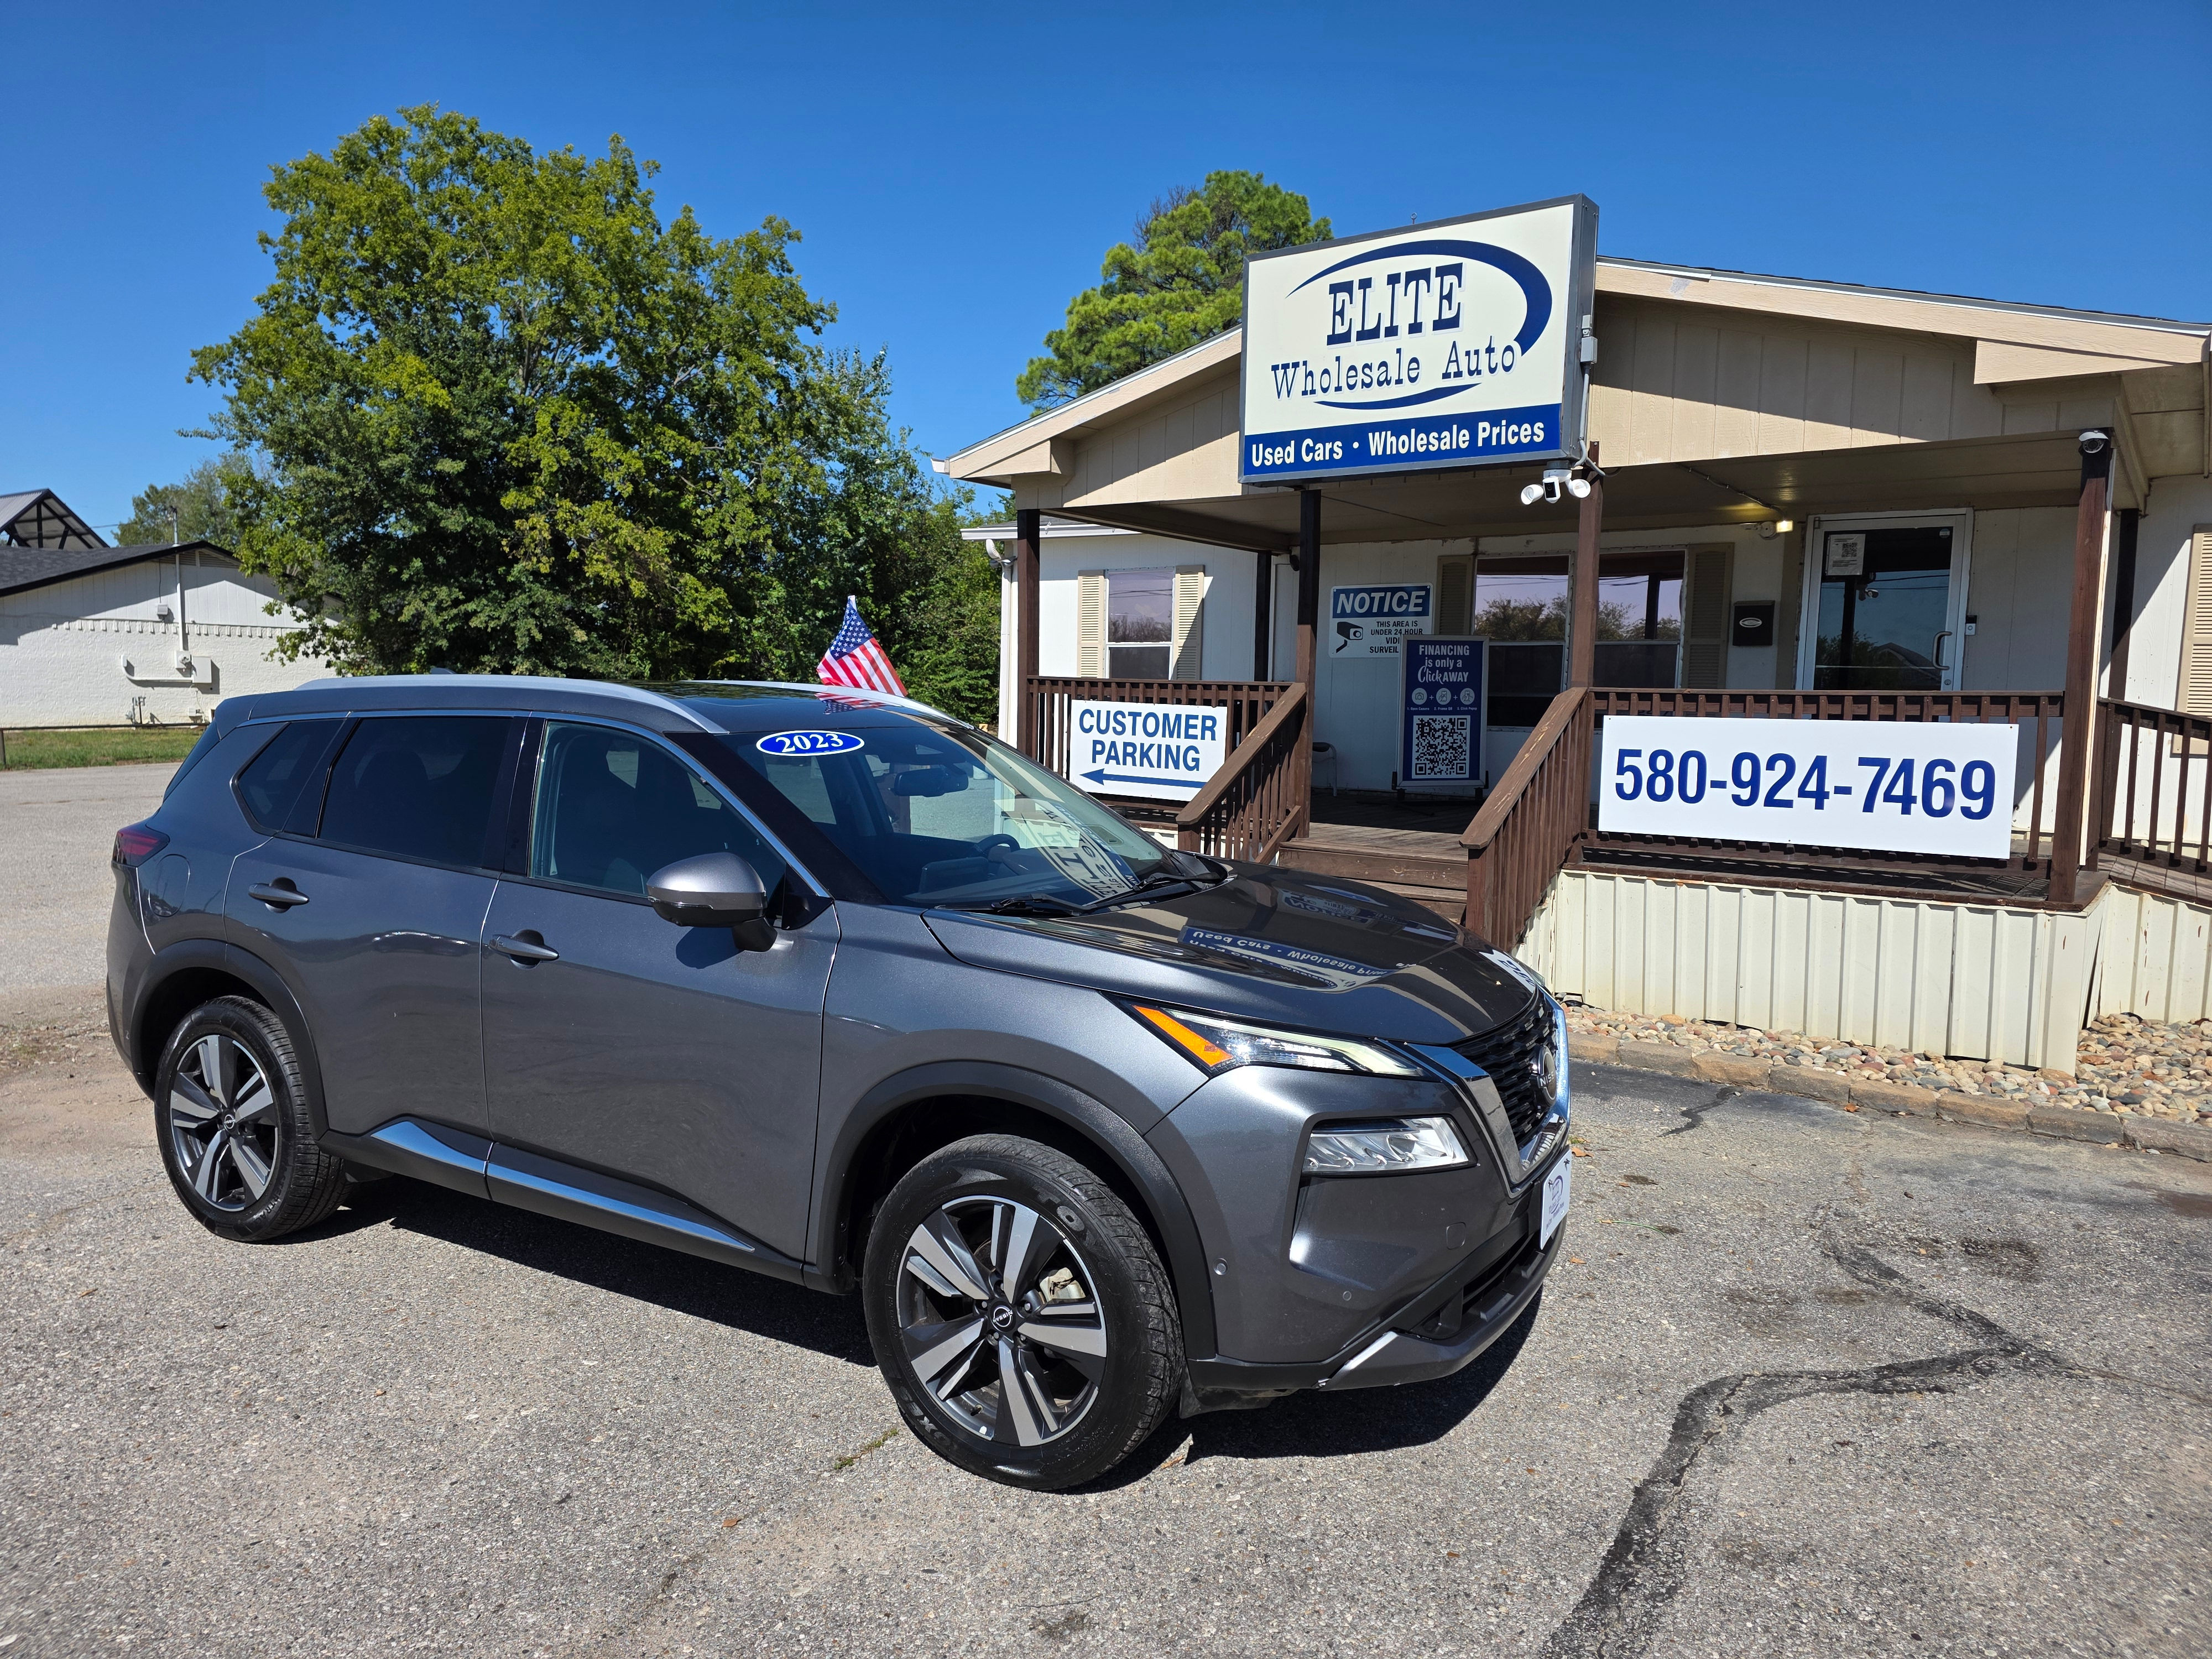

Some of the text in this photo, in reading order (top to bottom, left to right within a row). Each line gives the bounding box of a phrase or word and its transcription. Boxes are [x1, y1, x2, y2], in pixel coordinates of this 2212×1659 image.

[1327, 263, 1463, 346] ELITE
[1271, 336, 1515, 399] Wholesale Auto
[1251, 420, 1545, 467] Used Cars Wholesale Prices
[1337, 591, 1426, 614] NOTICE
[1419, 645, 1469, 655] FINANCING
[1425, 657, 1462, 670] is only a
[1079, 708, 1217, 741] CUSTOMER
[775, 733, 843, 753] 2023
[1092, 739, 1200, 771] PARKING
[1615, 748, 1996, 821] 580-924-7469
